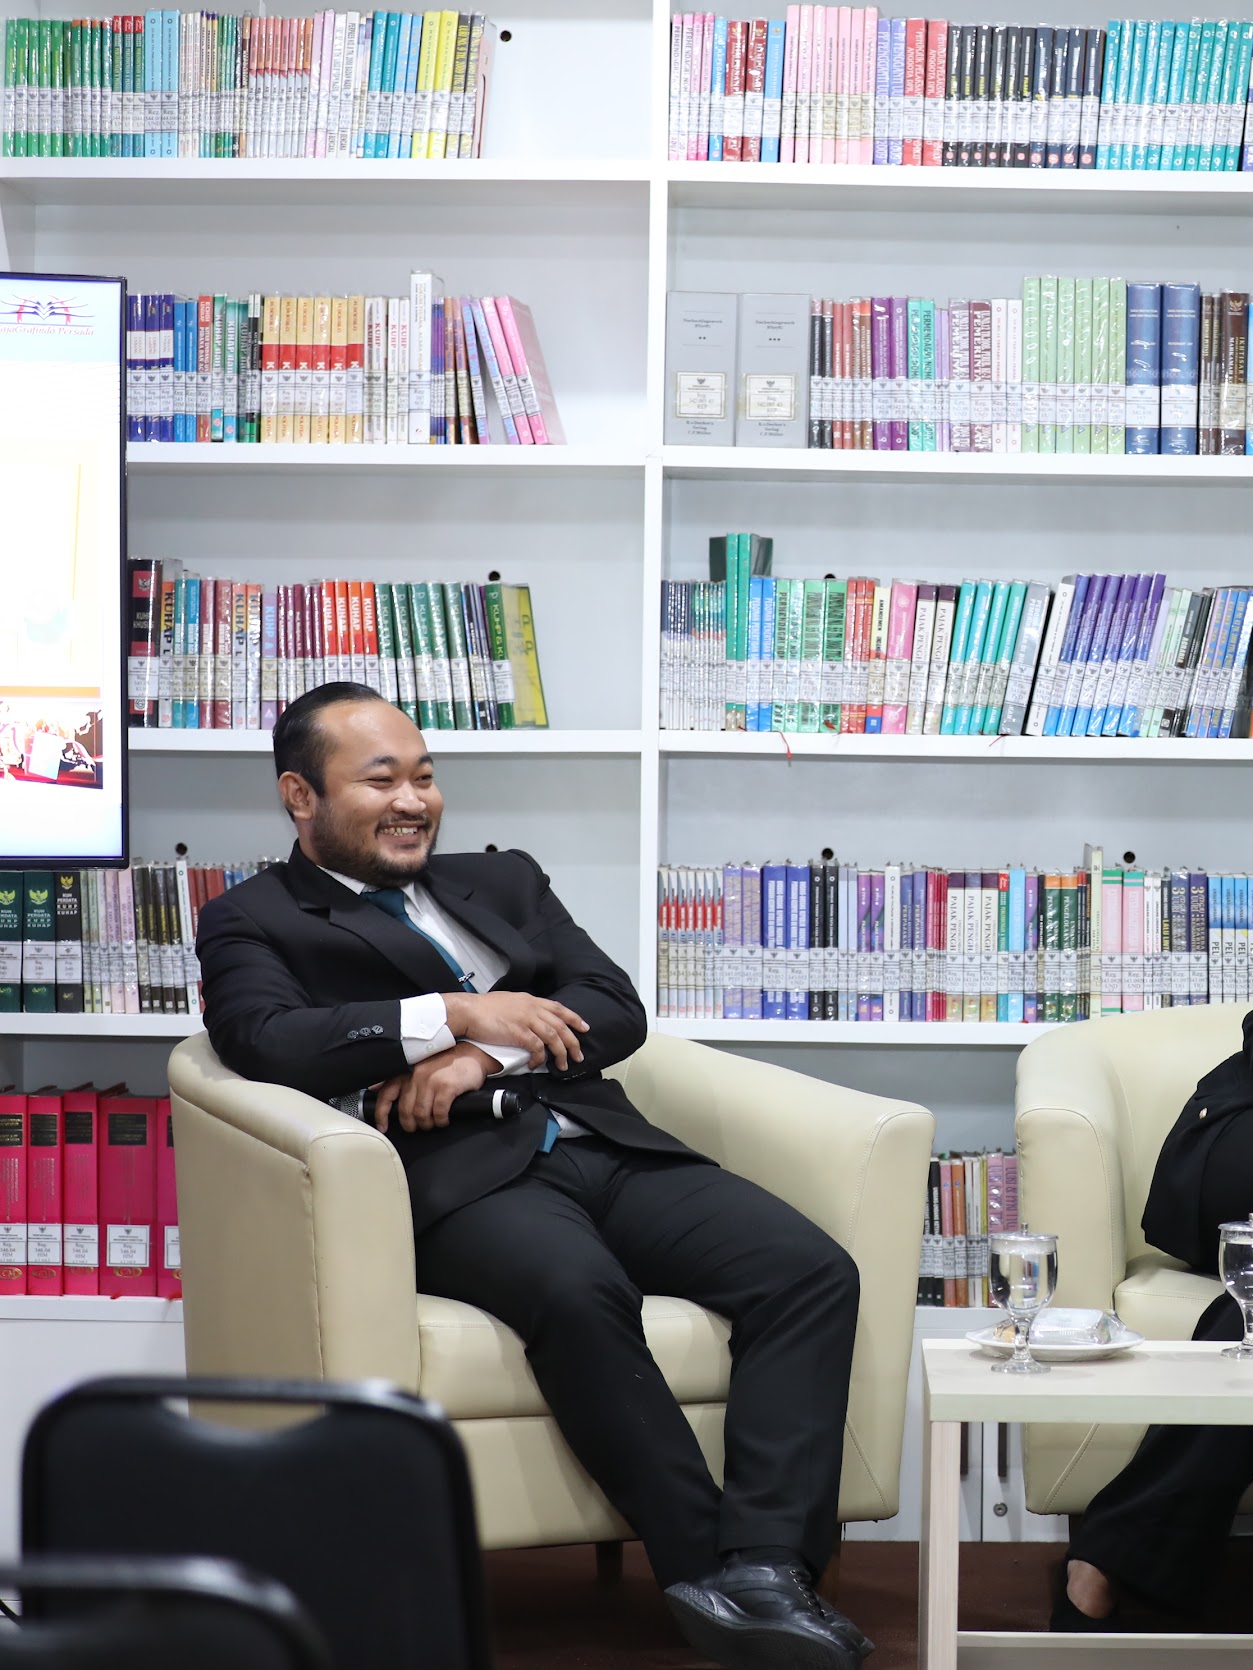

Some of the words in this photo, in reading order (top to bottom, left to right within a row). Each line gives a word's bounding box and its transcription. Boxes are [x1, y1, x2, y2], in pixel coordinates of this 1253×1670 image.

[235, 594, 244, 645] KUHAP
[265, 606, 275, 638] KUHP
[967, 895, 975, 921] PAJAK
[984, 896, 992, 921] PAJAK
